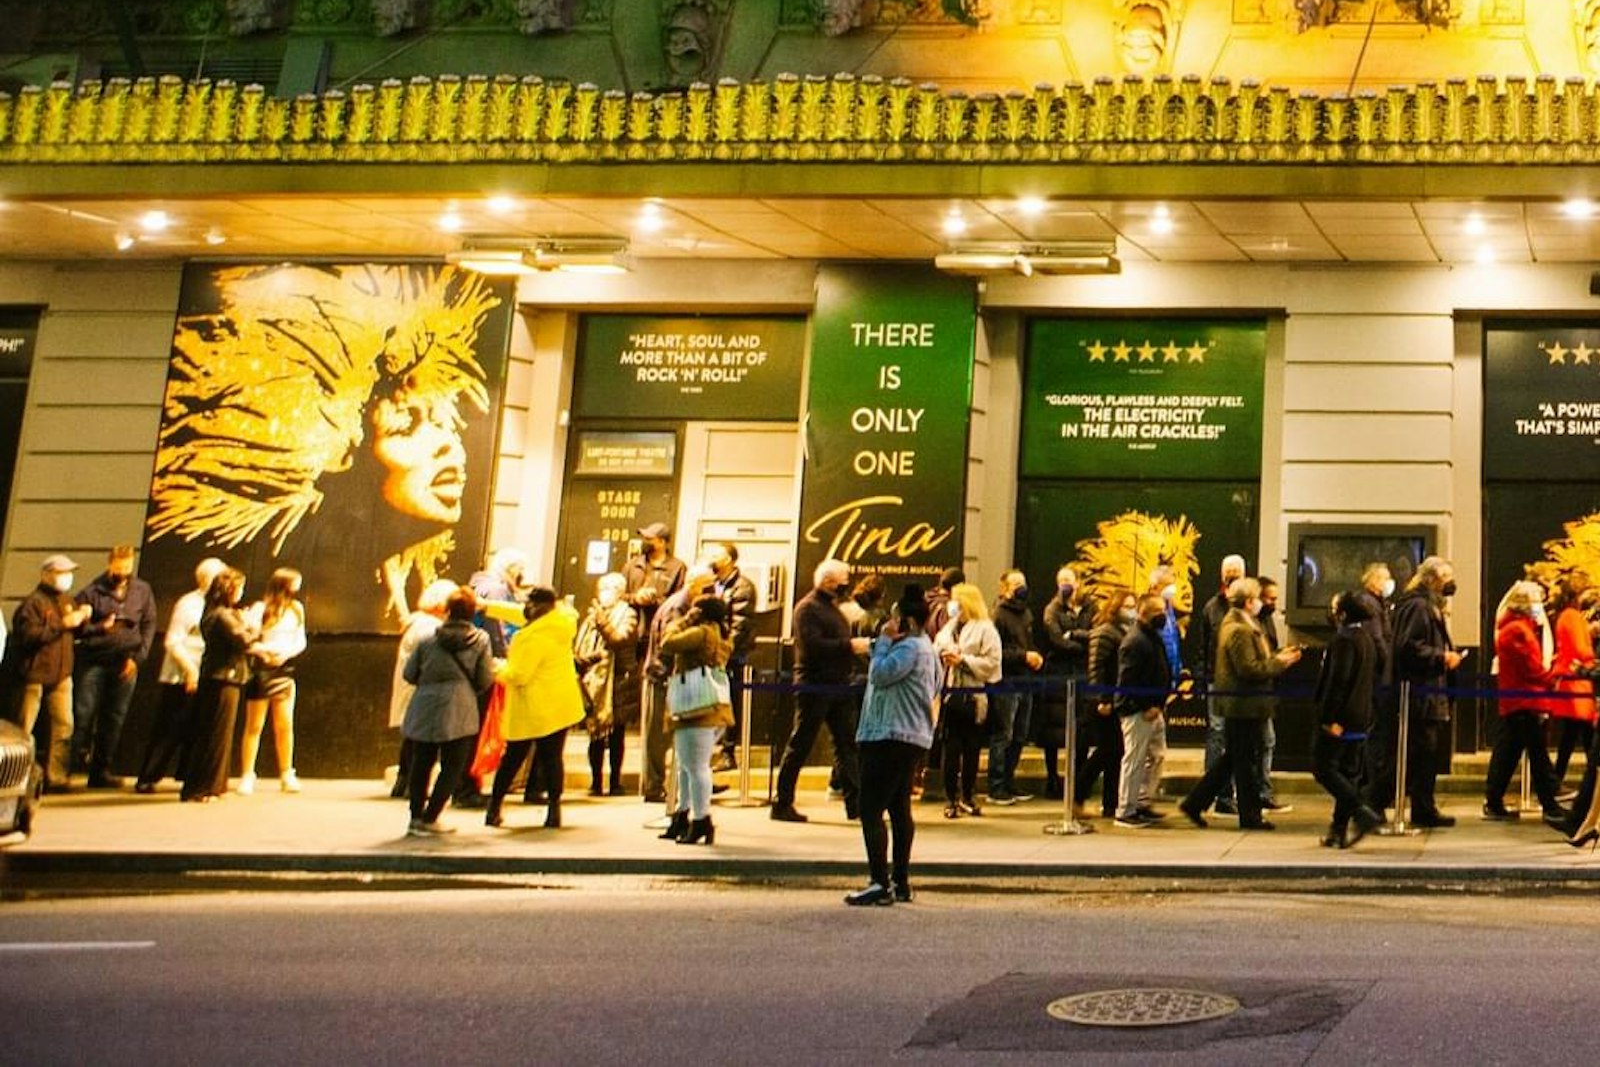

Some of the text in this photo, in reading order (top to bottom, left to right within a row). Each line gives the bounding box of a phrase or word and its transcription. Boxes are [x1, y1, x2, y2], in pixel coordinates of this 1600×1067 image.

[687, 334, 725, 348] SOUL
[728, 335, 760, 349] AND
[851, 323, 934, 347] THERE
[620, 351, 768, 365] MORE THAN A BIT OF
[637, 368, 678, 382] ROCK
[879, 365, 902, 390] IS
[1106, 395, 1155, 406] FLAWLESS
[1156, 395, 1179, 406] AND
[1181, 396, 1218, 407] DEEPLY
[851, 407, 924, 433] ONLY
[1084, 408, 1204, 423] THE ELECTRICITY
[1062, 424, 1078, 438] IN
[1081, 424, 1108, 438] THE
[1109, 424, 1137, 438] AIR
[1515, 420, 1565, 435] THAT’S
[853, 450, 914, 476] ONE
[597, 491, 641, 504] STAGE
[600, 506, 636, 518] DOOR
[805, 496, 955, 563] Tina
[858, 565, 876, 574] TINA
[877, 565, 908, 574] TURNER
[910, 565, 943, 575] MUSICAL
[1168, 717, 1206, 726] MUSICAL
